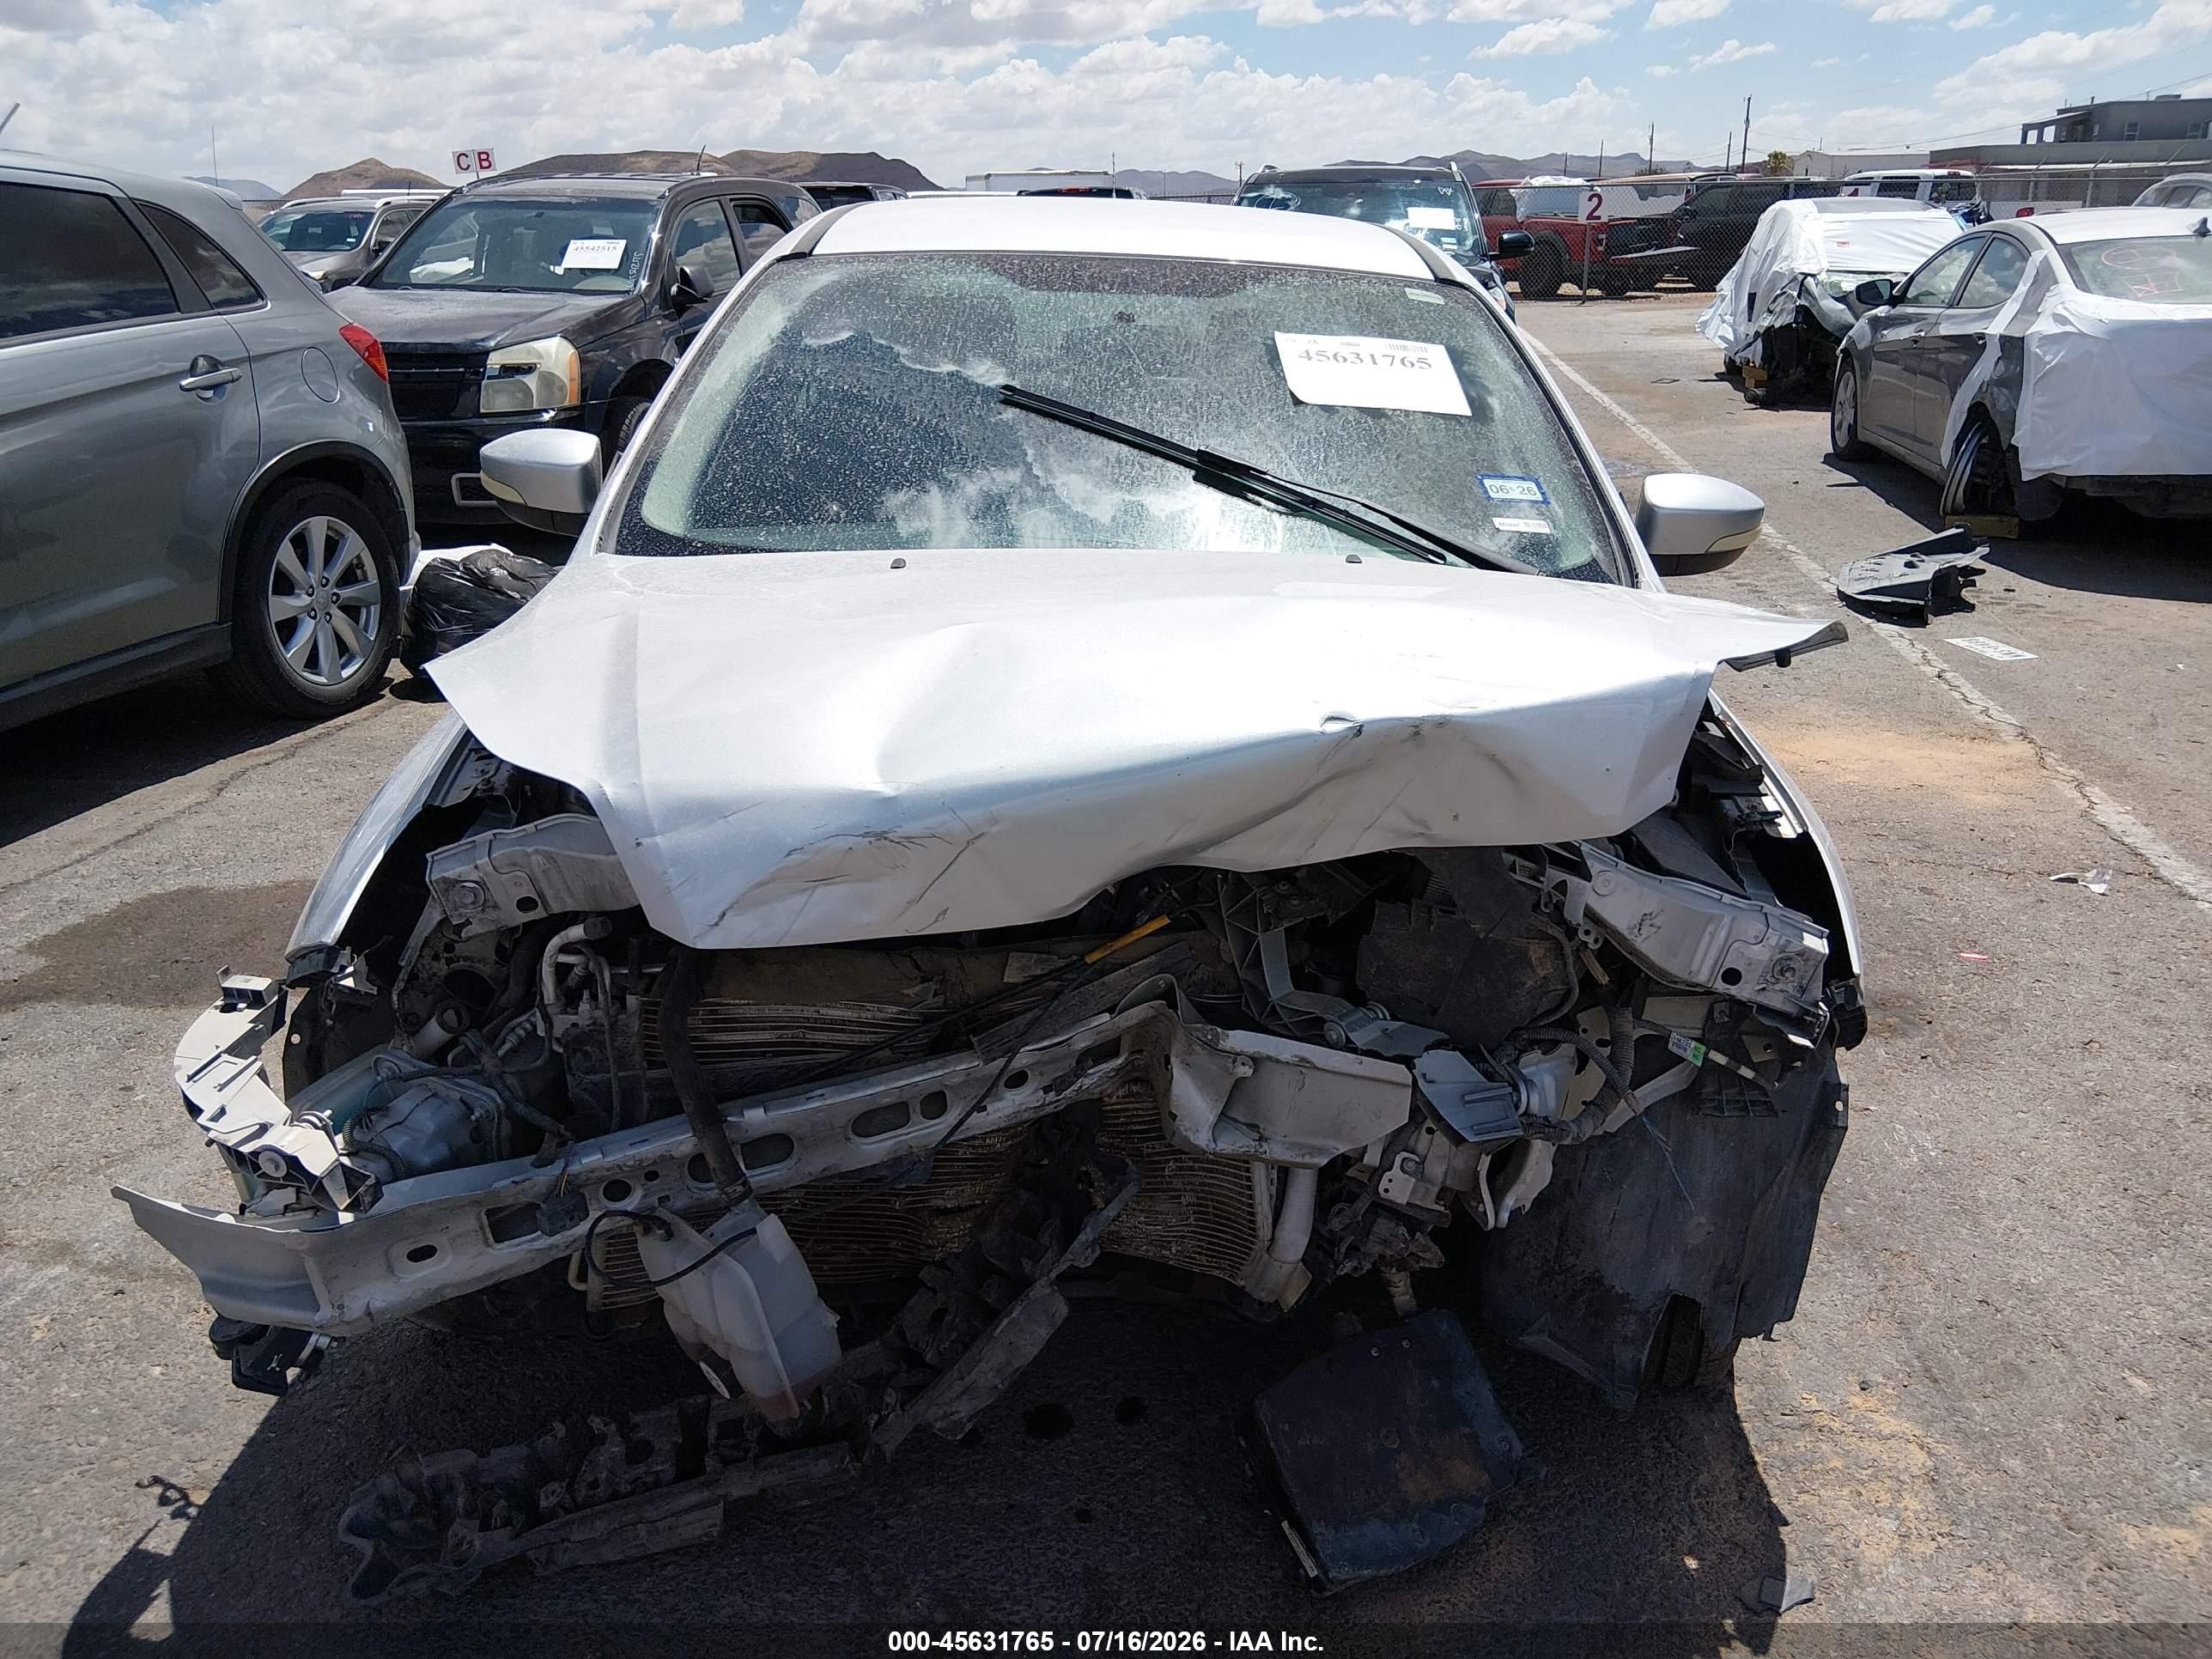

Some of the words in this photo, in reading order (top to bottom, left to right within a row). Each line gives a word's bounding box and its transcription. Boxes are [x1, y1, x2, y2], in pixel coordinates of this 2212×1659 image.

[456, 152, 471, 172] C
[477, 150, 492, 170] B
[1585, 192, 1603, 221] 2
[1297, 349, 1432, 370] 45631765
[1489, 483, 1510, 495] 06
[1516, 485, 1537, 496] 26
